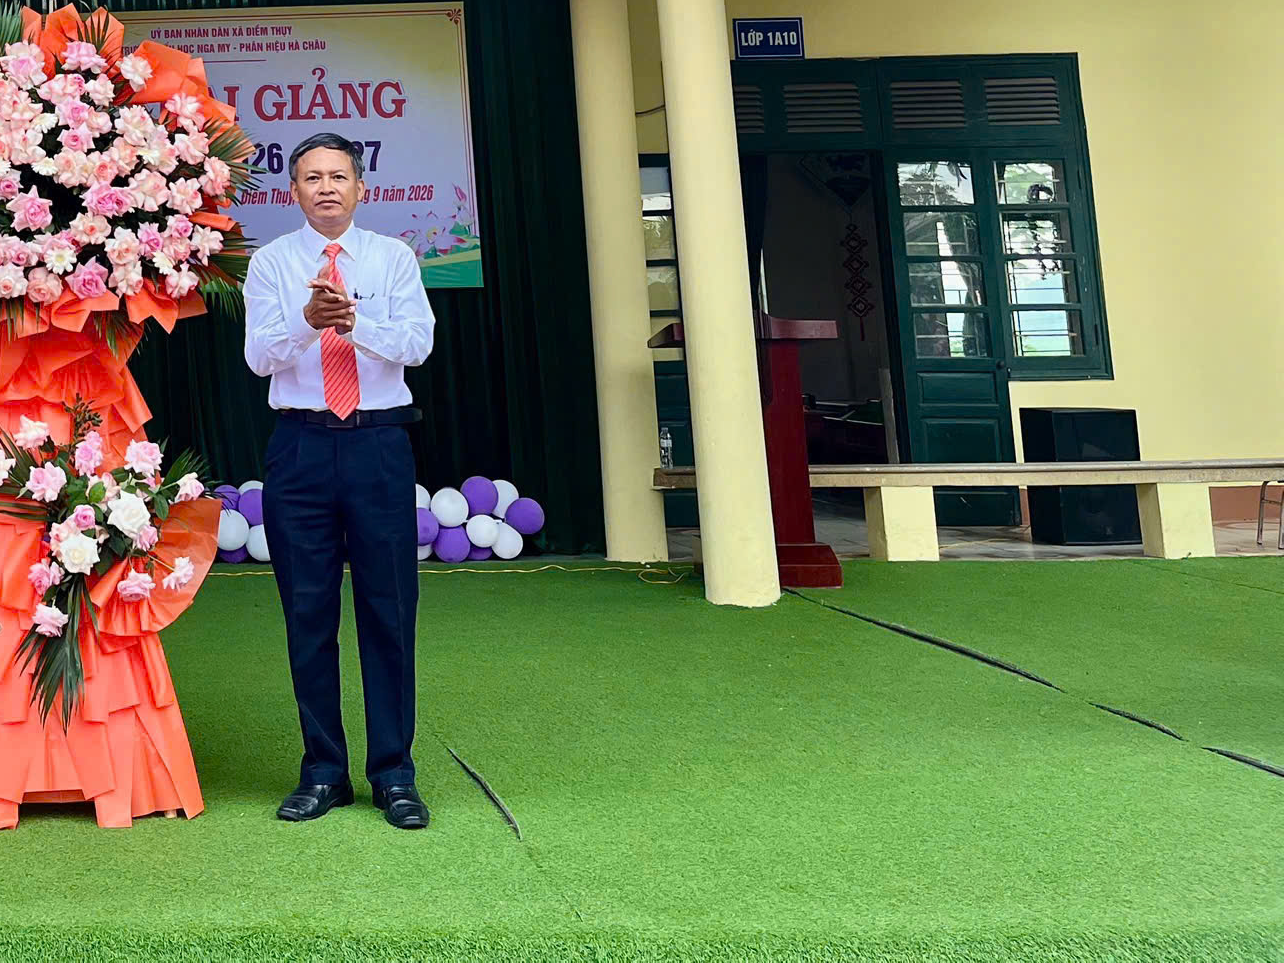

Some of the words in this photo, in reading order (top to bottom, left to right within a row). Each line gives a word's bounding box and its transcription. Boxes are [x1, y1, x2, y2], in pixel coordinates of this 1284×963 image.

[164, 28, 182, 39] BAN
[184, 26, 209, 38] NHÂN
[232, 25, 244, 37] XÃ
[740, 28, 764, 46] LỚP
[767, 31, 798, 46] 1A10
[197, 43, 215, 54] NGA
[239, 40, 263, 53] PHÂN
[302, 38, 327, 51] CHÂU
[253, 67, 407, 122] GIẢNG
[372, 185, 381, 202] 9
[382, 185, 406, 202] năm
[407, 184, 434, 202] 2026
